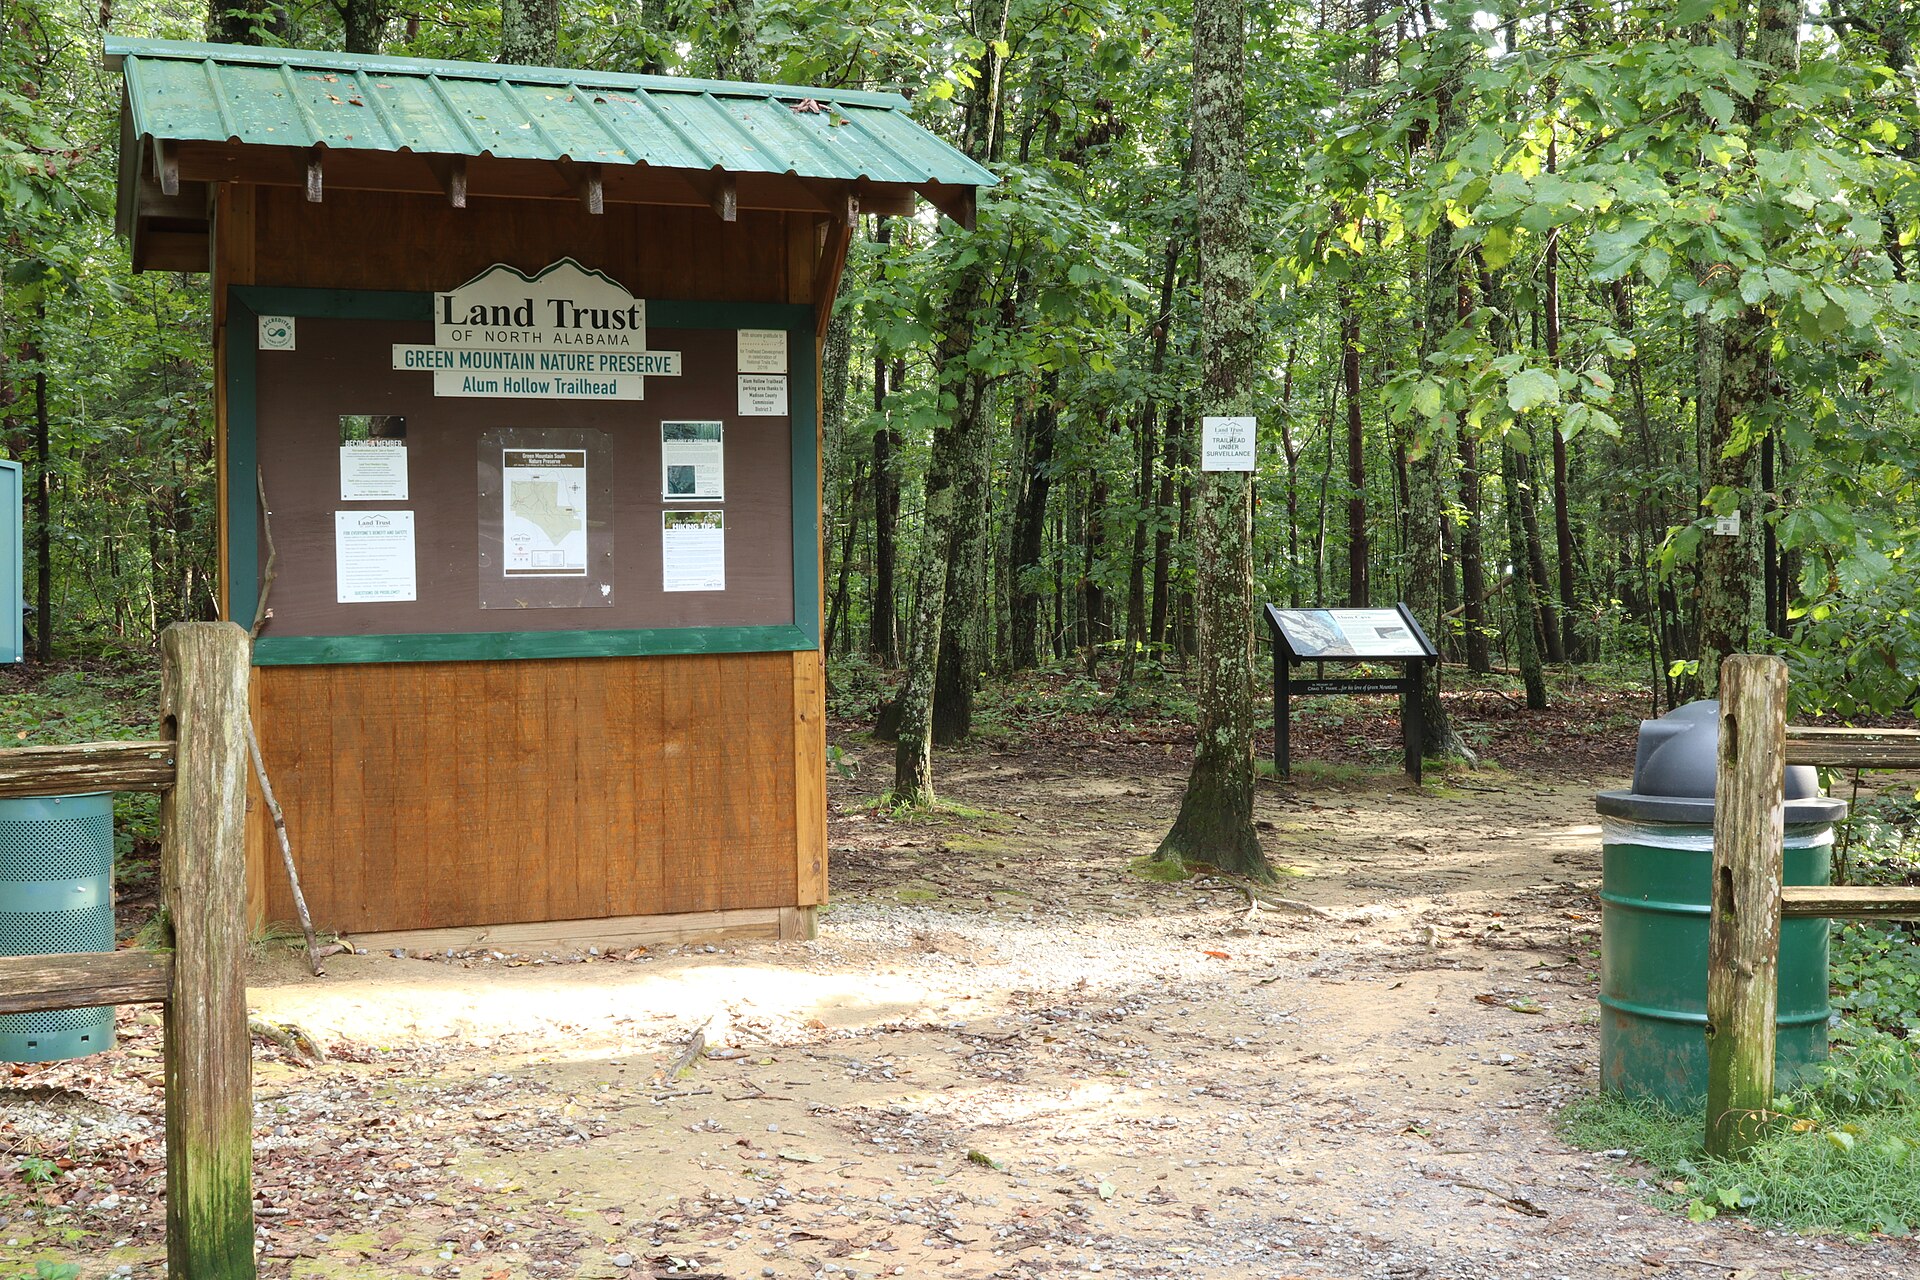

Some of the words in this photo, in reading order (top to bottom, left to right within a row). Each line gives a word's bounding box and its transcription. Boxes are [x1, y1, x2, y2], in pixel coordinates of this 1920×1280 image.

[440, 295, 535, 328] Land
[547, 298, 640, 330] Trust
[262, 317, 292, 329] ACCREDITED
[451, 329, 473, 342] OF
[485, 331, 543, 344] NORTH
[553, 333, 630, 346] ALABAMA
[405, 350, 454, 369] GREEN
[459, 351, 535, 371] MOUNTAIN
[540, 353, 595, 372] NATURE
[600, 355, 672, 374] PRESERVE
[462, 376, 498, 393] Alum
[503, 377, 550, 394] Hollow
[554, 378, 617, 395] Trailhead
